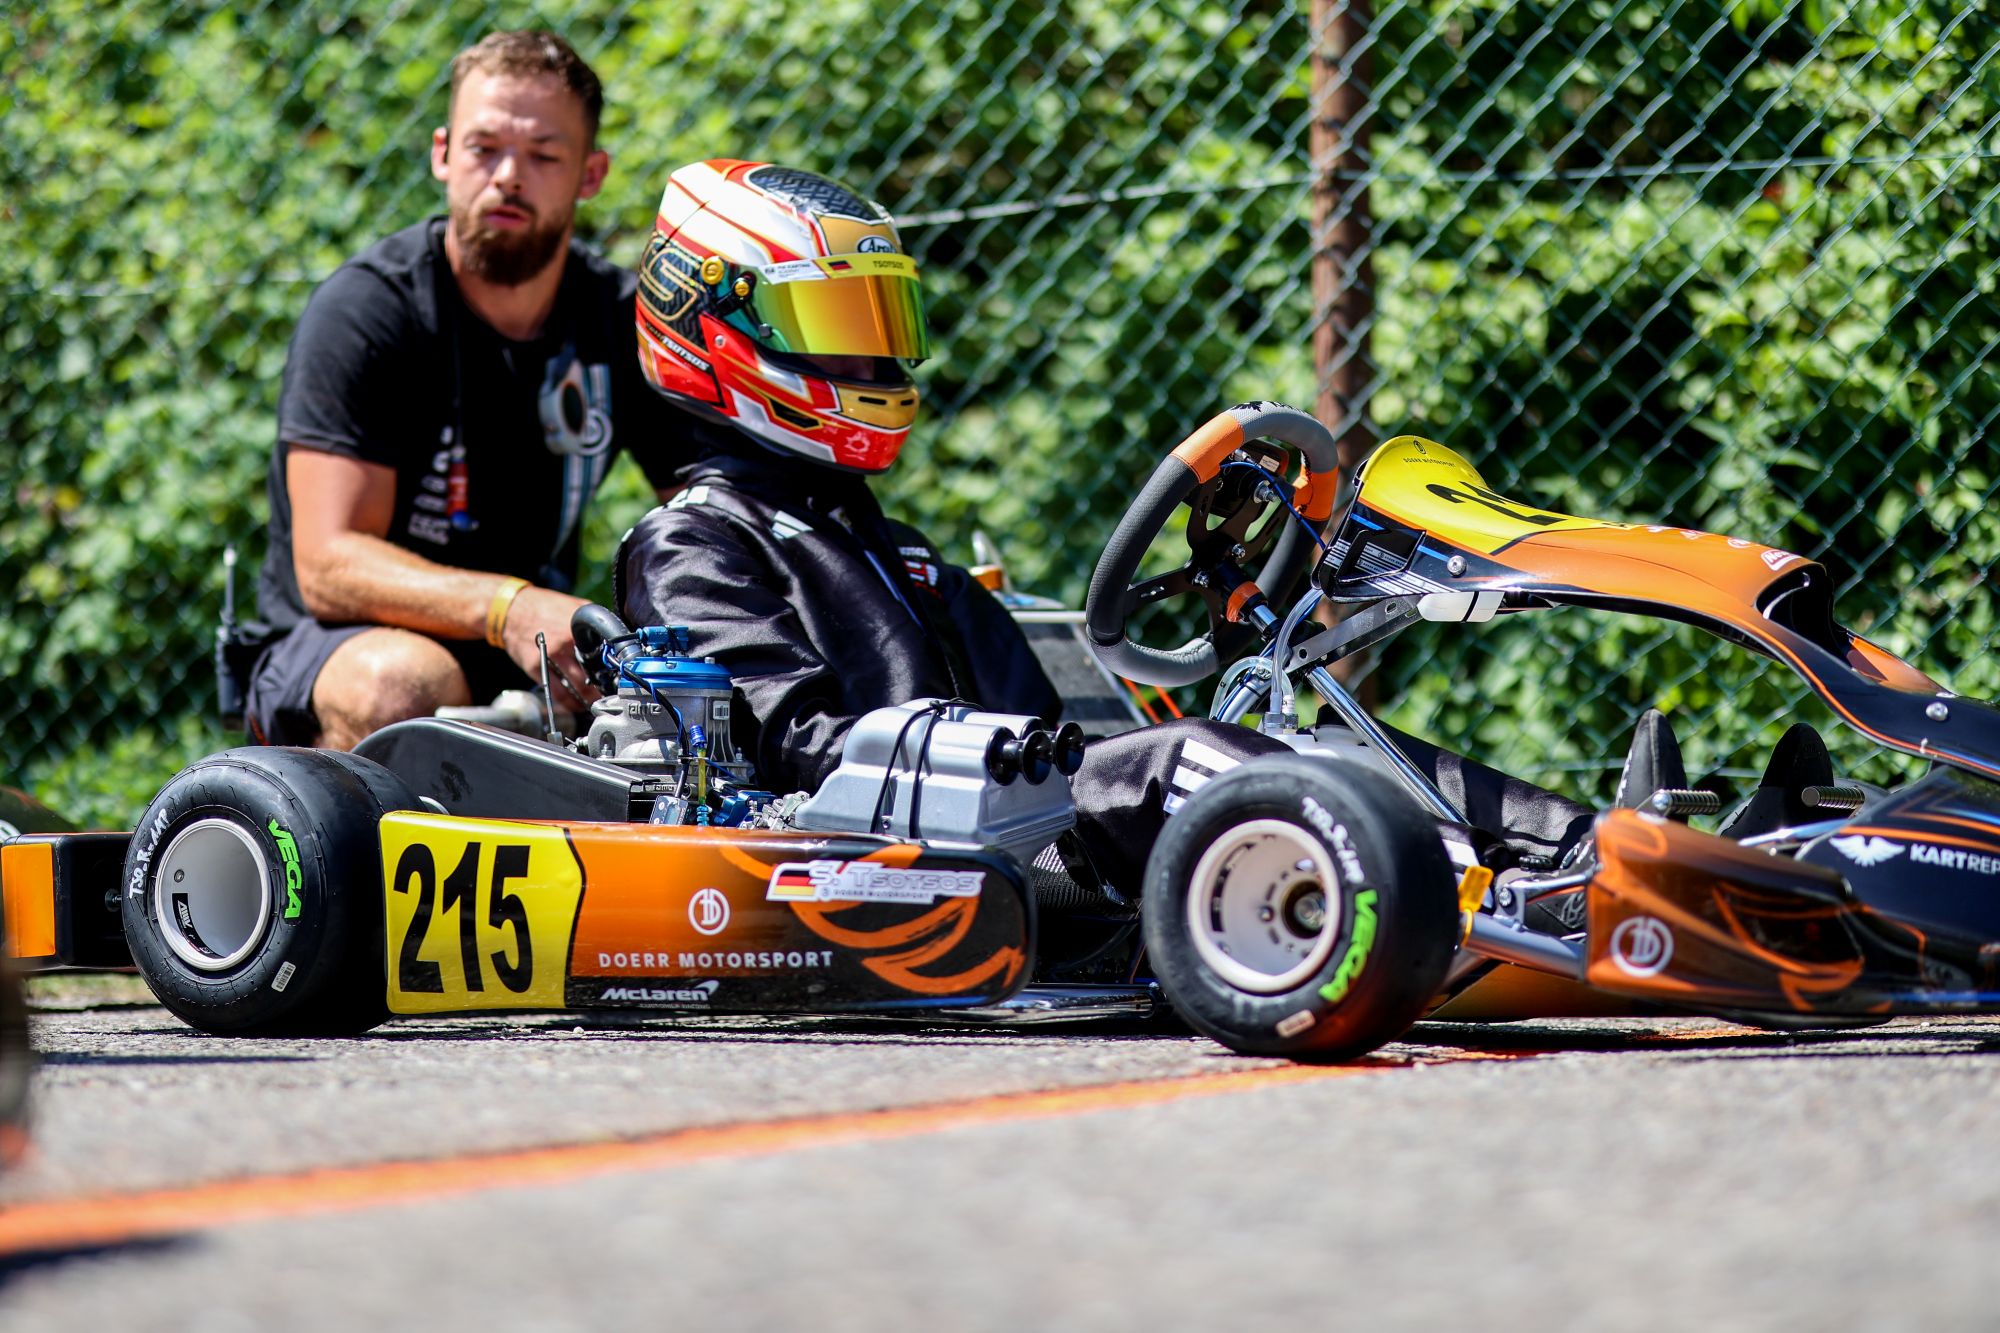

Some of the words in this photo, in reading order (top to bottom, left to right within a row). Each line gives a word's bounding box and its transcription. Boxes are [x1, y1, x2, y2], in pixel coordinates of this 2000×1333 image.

[268, 819, 303, 918] VEGA
[393, 842, 534, 993] 215
[599, 952, 670, 969] DOERR
[678, 951, 833, 969] MOTORSPORT
[600, 987, 709, 1002] McLaren
[1318, 889, 1378, 1004] VEGA
